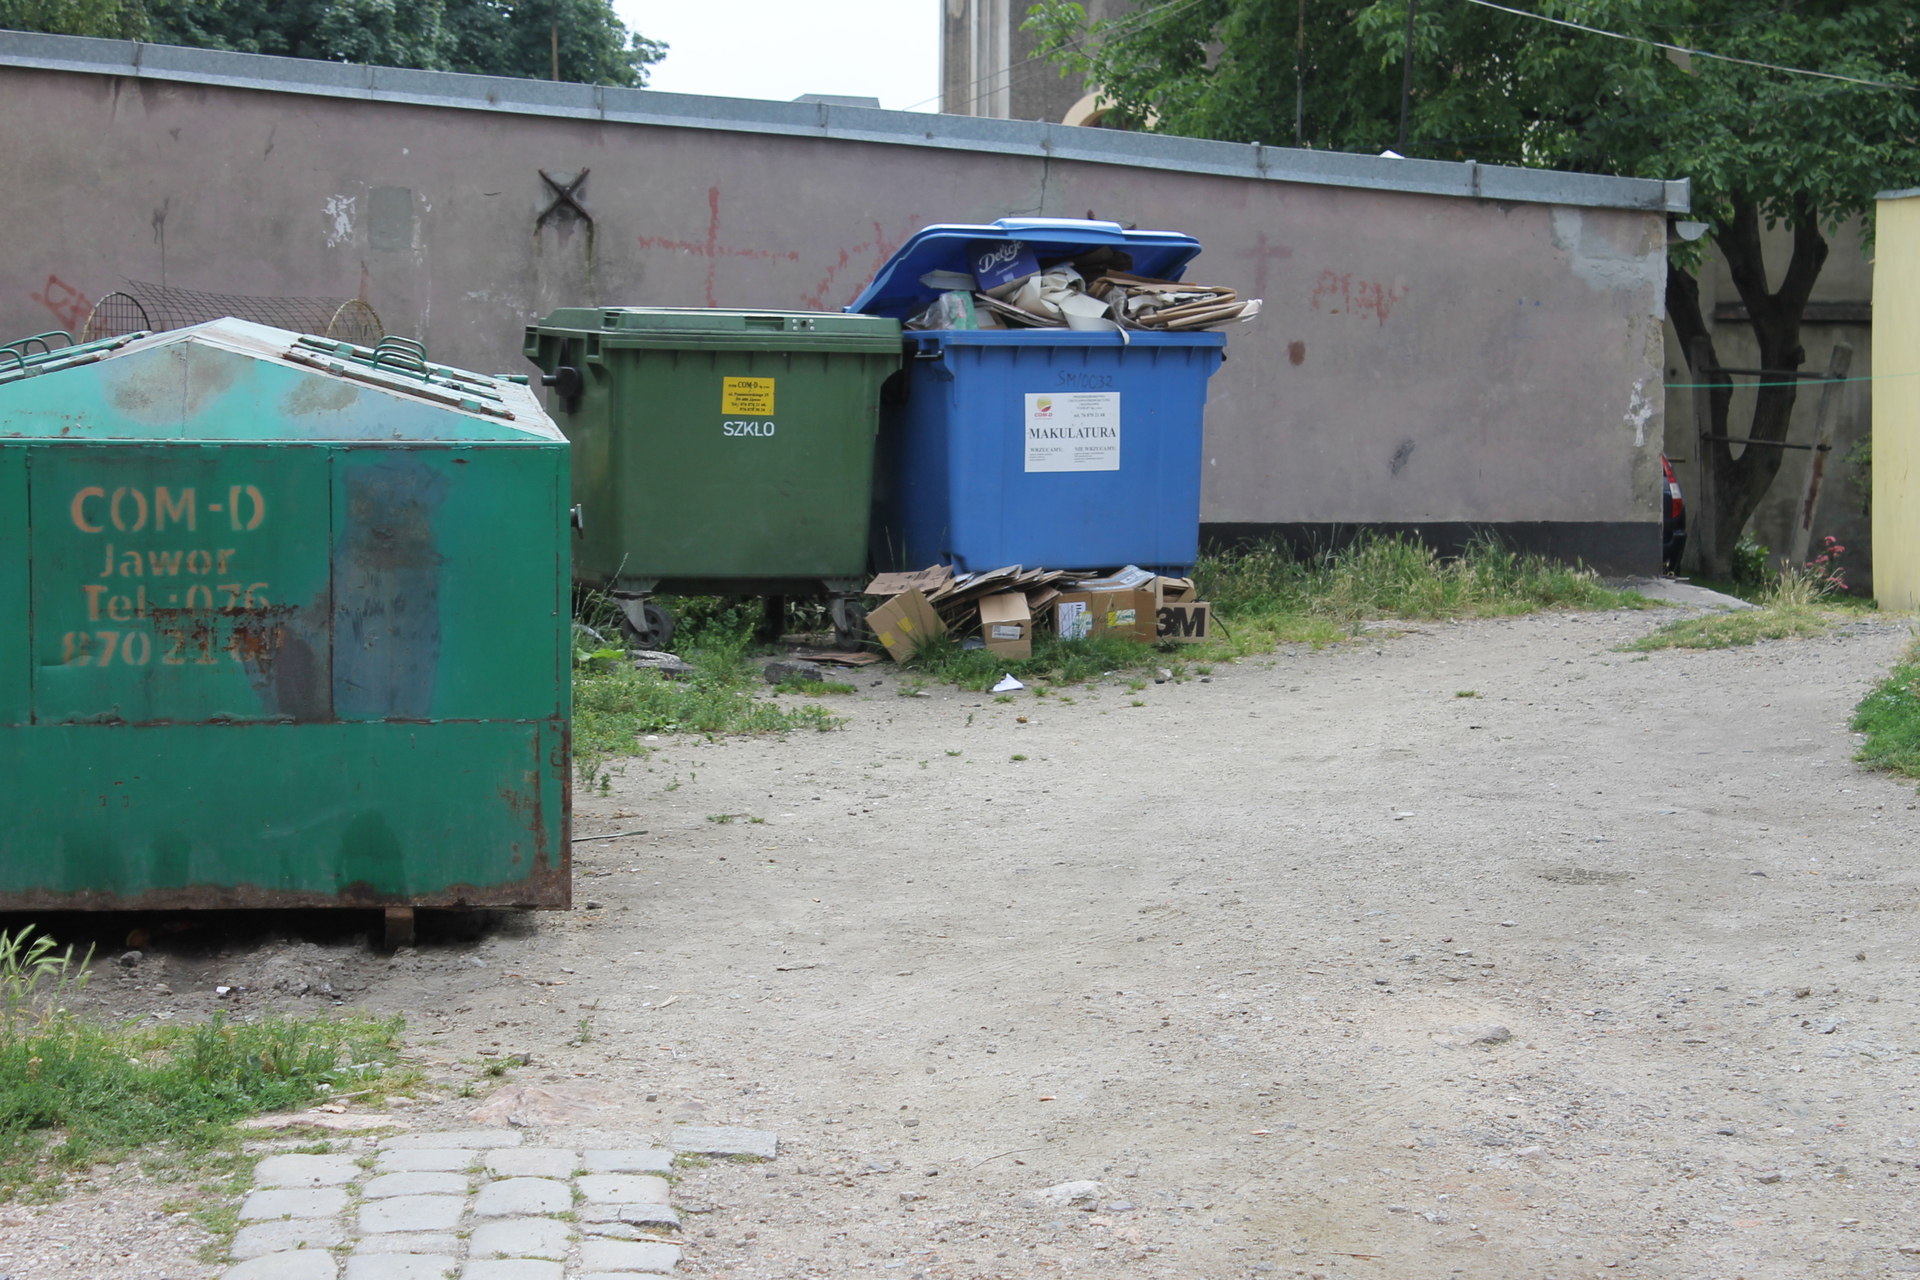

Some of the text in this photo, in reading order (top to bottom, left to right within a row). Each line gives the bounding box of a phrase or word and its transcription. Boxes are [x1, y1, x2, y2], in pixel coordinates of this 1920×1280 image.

[723, 421, 775, 437] SZKŁO
[1029, 427, 1117, 439] MAKULATURA
[100, 543, 236, 578] Jawor
[1155, 606, 1206, 638] 3M
